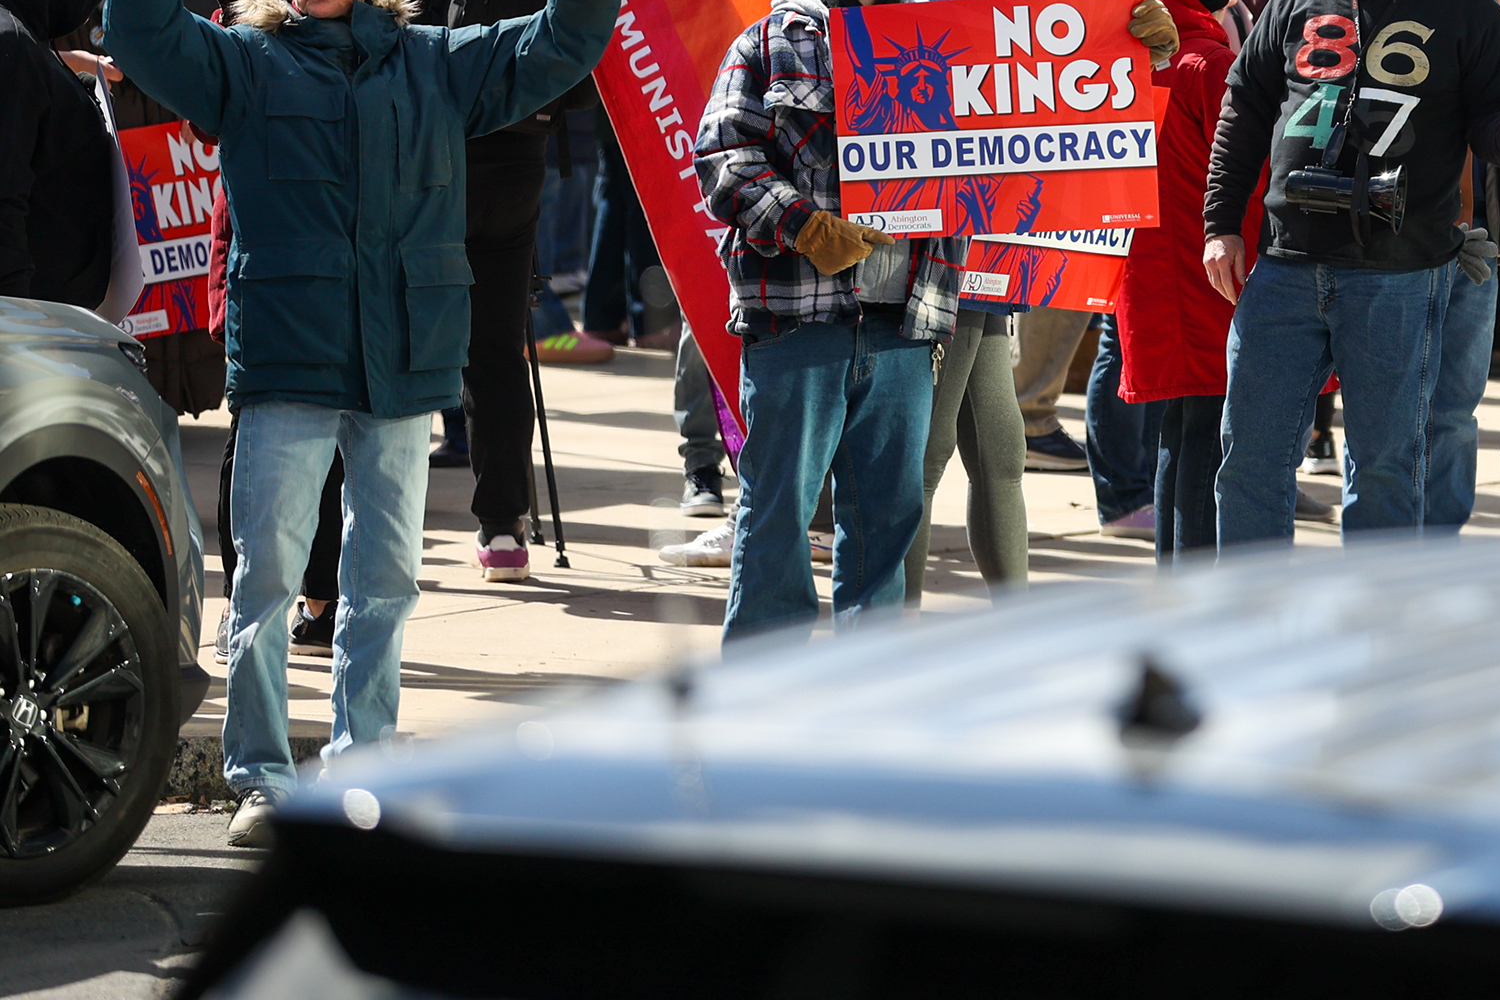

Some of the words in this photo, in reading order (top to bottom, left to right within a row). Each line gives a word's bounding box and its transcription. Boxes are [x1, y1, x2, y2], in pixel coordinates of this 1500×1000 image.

[992, 3, 1086, 58] NO
[951, 56, 1136, 117] KINGS
[167, 131, 220, 177] NO
[842, 140, 918, 173] OUR
[931, 127, 1152, 169] DEMOCRACY
[887, 222, 932, 231] Democrats
[890, 214, 928, 225] Abington
